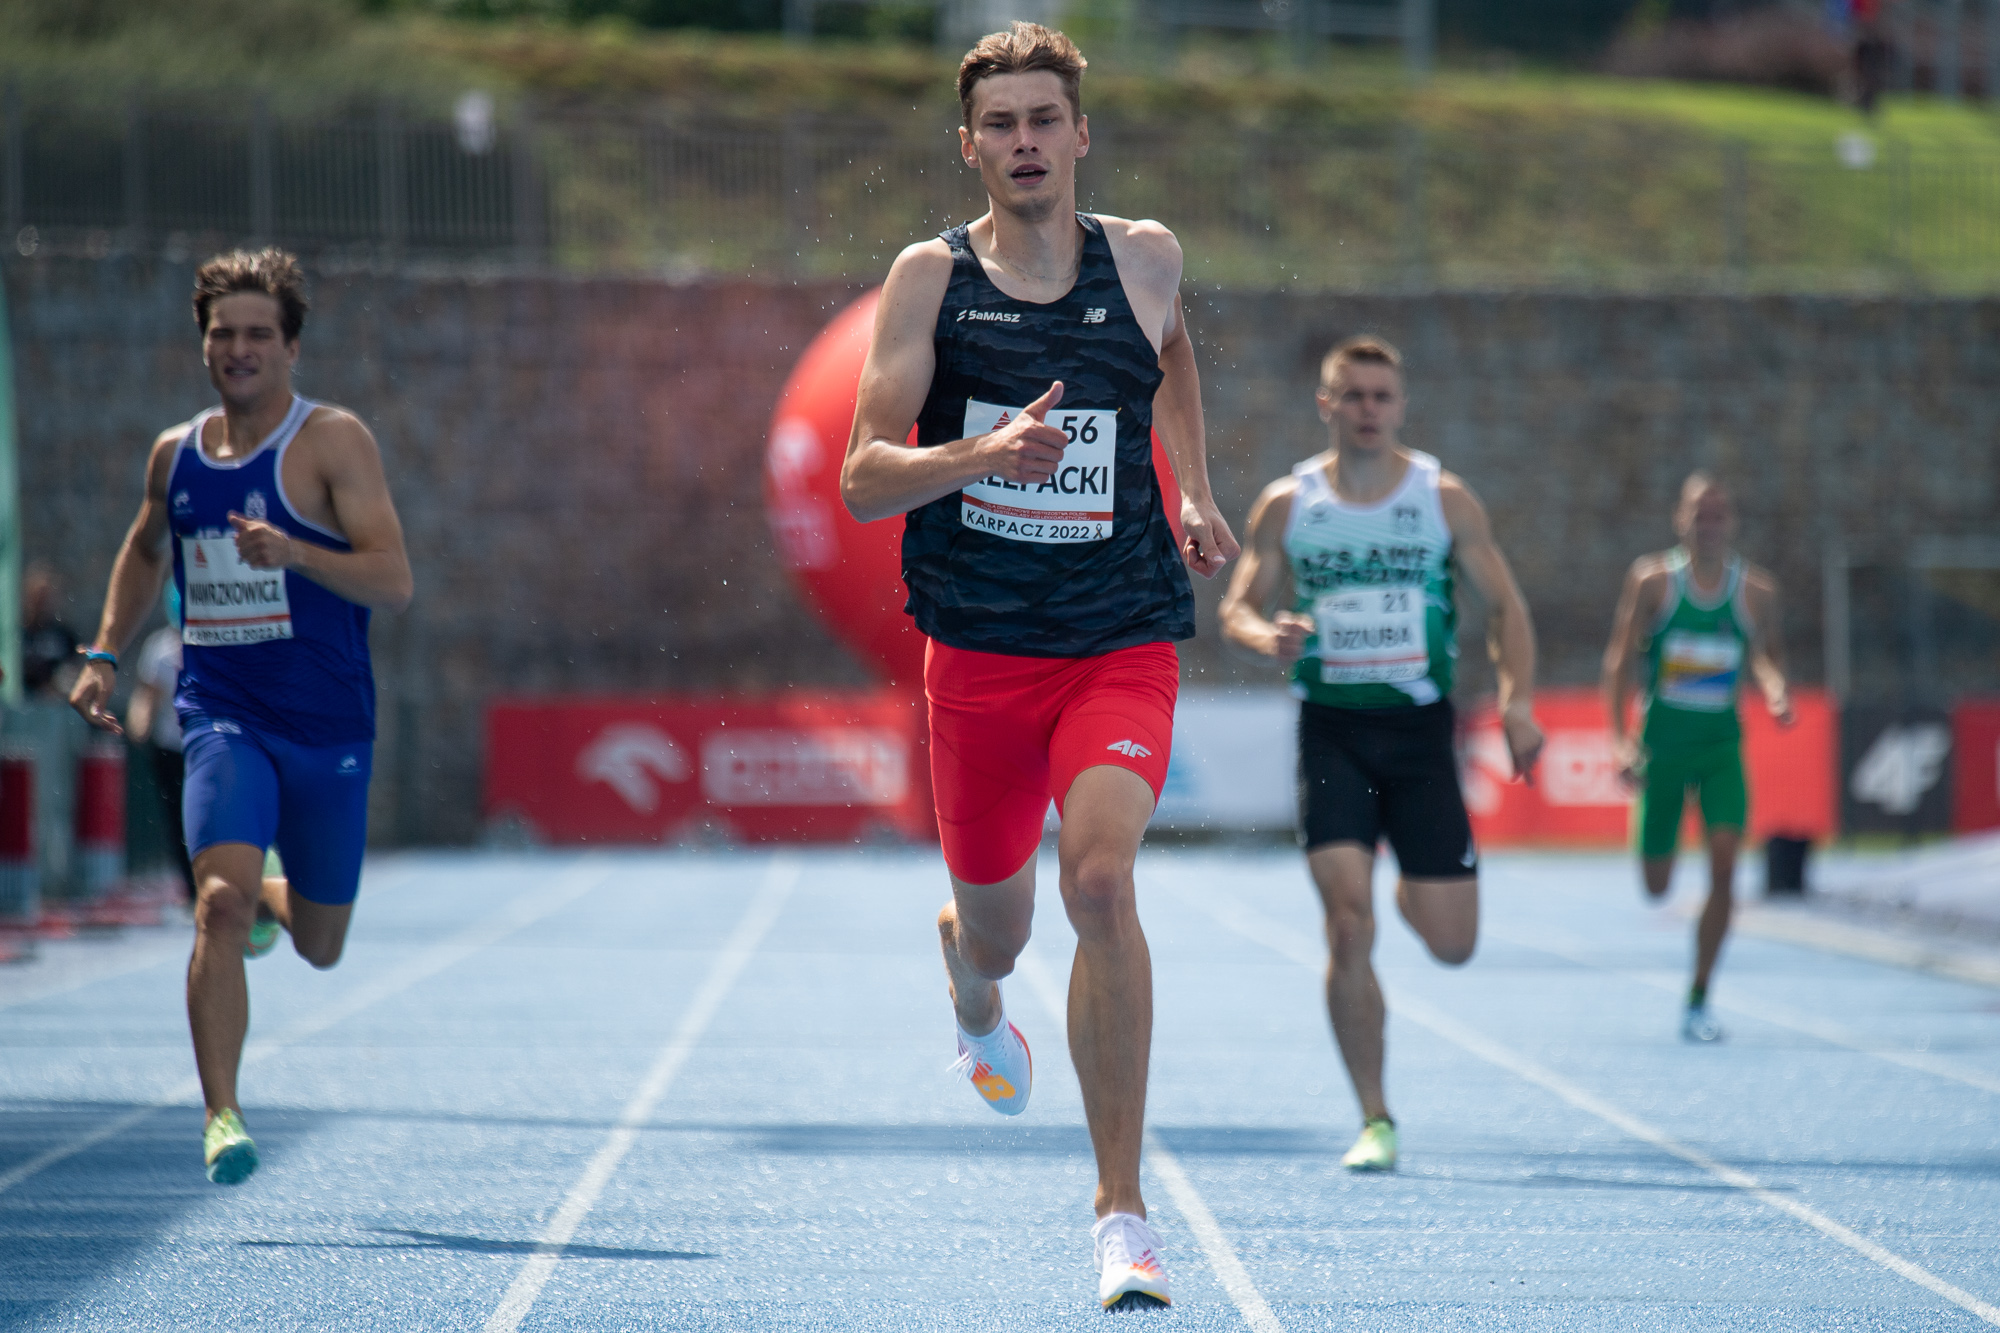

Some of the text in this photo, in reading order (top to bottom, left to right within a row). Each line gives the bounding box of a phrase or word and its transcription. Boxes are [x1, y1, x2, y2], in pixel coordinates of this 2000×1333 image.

[967, 310, 1021, 323] SaMASZ
[1062, 416, 1099, 445] 56
[978, 466, 1108, 495] ACKI
[966, 509, 1090, 539] KARPACZ 2022
[1382, 593, 1409, 614] 21
[242, 626, 273, 641] 2022
[1106, 739, 1152, 758] 4F
